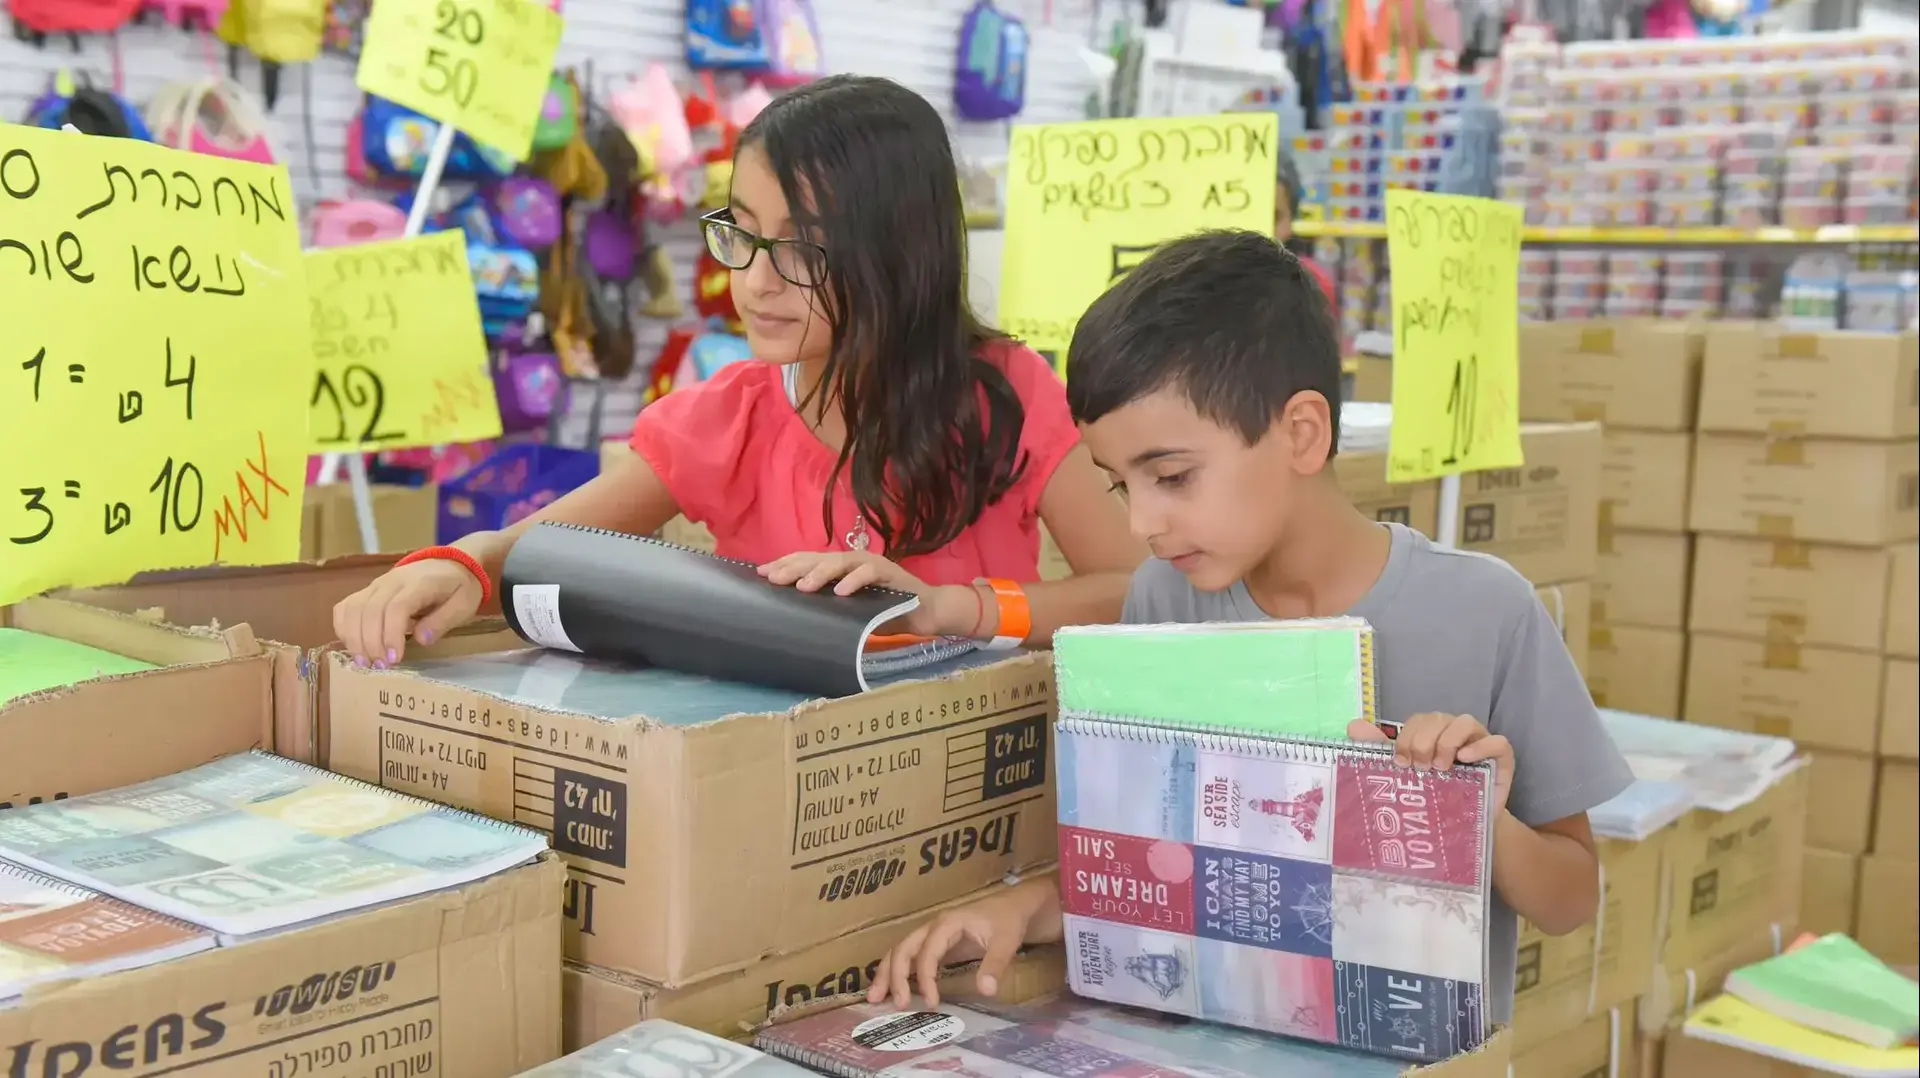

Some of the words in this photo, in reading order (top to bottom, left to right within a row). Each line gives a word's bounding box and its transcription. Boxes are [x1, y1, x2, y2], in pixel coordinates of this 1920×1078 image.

[434, 0, 484, 45] 20
[418, 47, 479, 110] 50
[1118, 123, 1270, 181] מחברת
[77, 162, 285, 224] מחברת
[1203, 180, 1251, 211] A5
[164, 337, 196, 420] 4
[311, 364, 407, 443] 12
[10, 486, 54, 545] 3
[150, 456, 204, 535] 10
[214, 430, 290, 562] MAX
[385, 729, 415, 753] נושא
[437, 741, 453, 763] 72
[456, 749, 487, 772] דפים
[994, 731, 1014, 760] 42
[385, 757, 420, 785] שורות
[805, 766, 840, 792] נושא
[867, 756, 883, 778] 72
[888, 747, 922, 773] דפים
[563, 779, 589, 811] 42
[803, 799, 844, 823] שורות
[1204, 783, 1214, 817] OUR
[1230, 780, 1246, 828] escape
[799, 821, 851, 852] מחברת
[854, 807, 905, 838] ספירלה
[918, 811, 1022, 876] IDEAS
[1367, 775, 1407, 867] BON
[1398, 772, 1436, 871] VOYAGE
[1072, 834, 1115, 858] SAIL
[1104, 861, 1133, 874] SET
[1075, 869, 1169, 907] DREAMS
[1205, 858, 1220, 912] CAN
[1221, 857, 1234, 936] ALWAYS
[1252, 861, 1270, 943] HOME
[1269, 865, 1281, 912] YOU
[1091, 899, 1142, 917] YOUR
[1148, 908, 1185, 925] LET
[1234, 908, 1251, 939] FIND
[1269, 916, 1281, 942] TO
[1079, 931, 1088, 958] OUR
[1091, 931, 1104, 988] ADVENTURE
[1082, 960, 1092, 984] LET
[7, 1001, 227, 1078] IDEAS
[268, 1041, 353, 1078] ספירלה
[360, 1018, 433, 1058] מחברת
